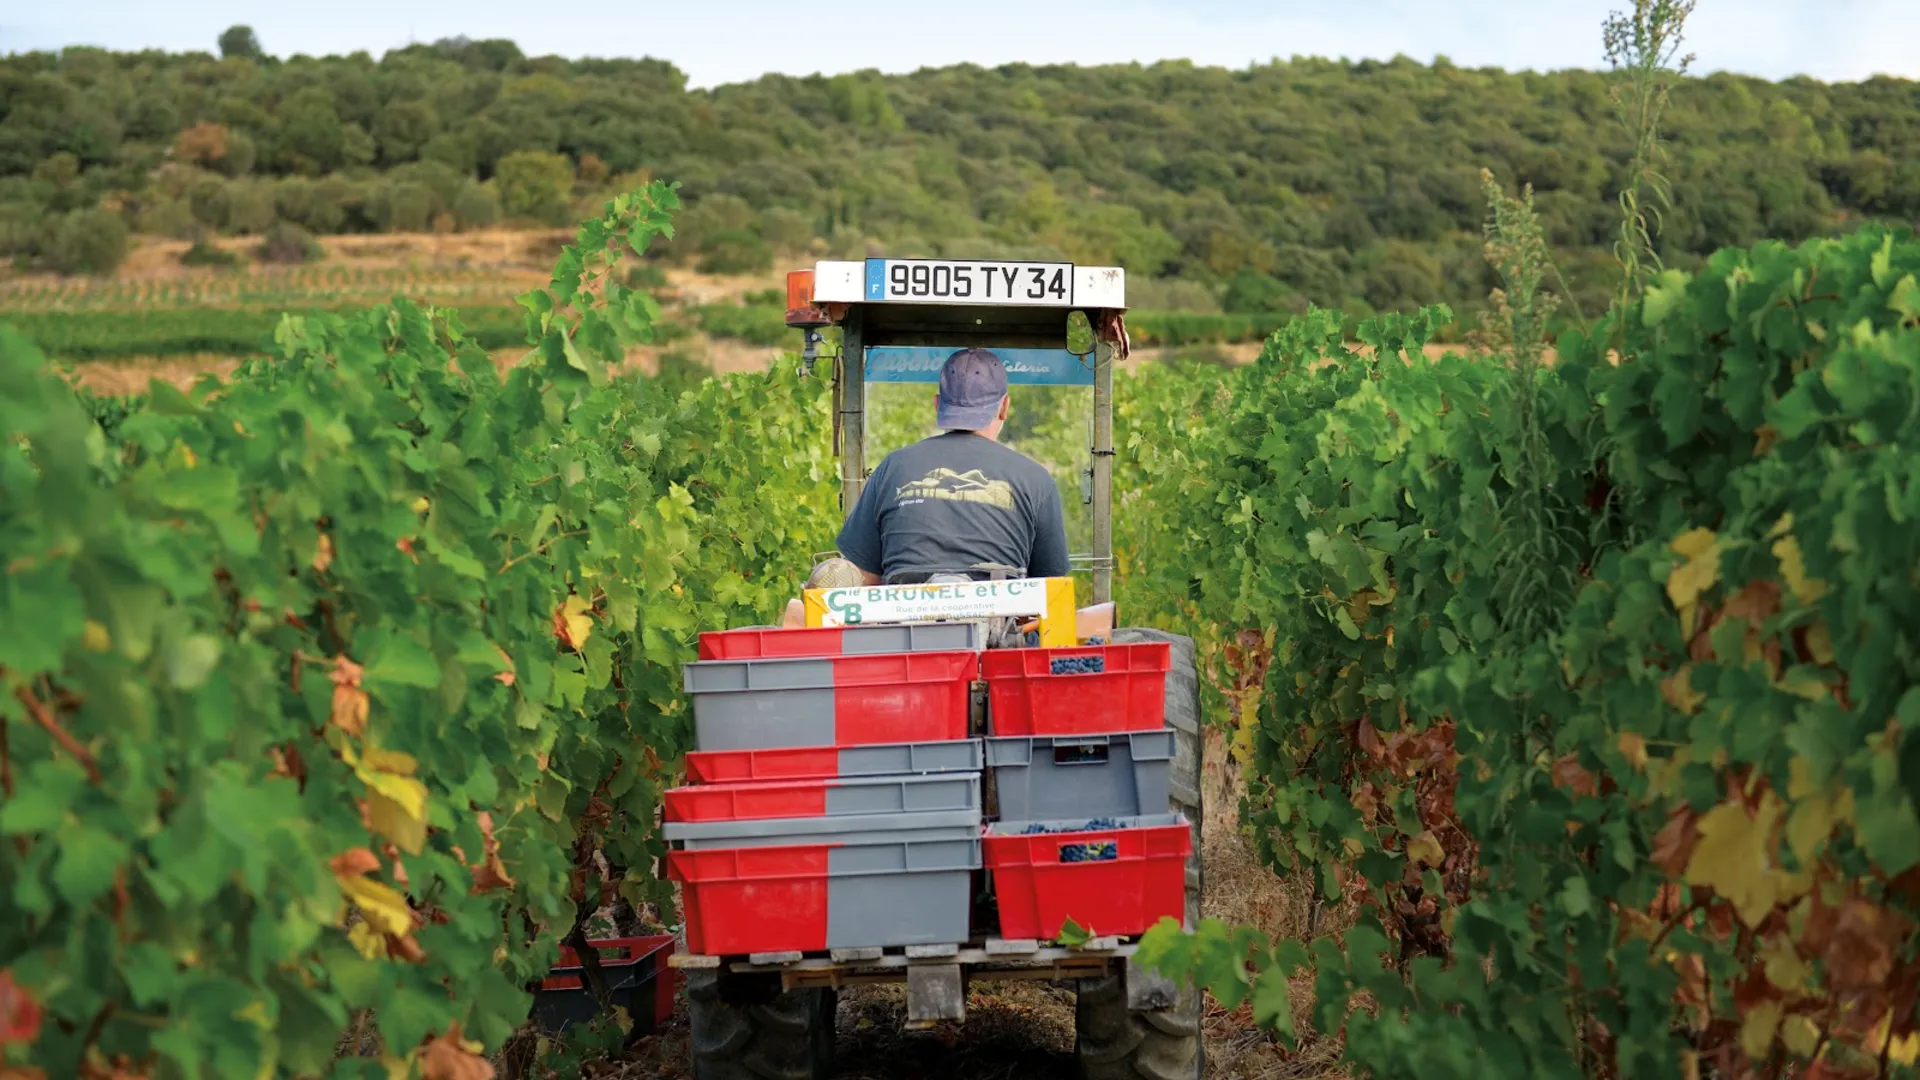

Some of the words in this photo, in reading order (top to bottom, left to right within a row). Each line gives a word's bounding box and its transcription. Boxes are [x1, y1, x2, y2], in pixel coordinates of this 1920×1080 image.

[872, 284, 880, 294] F
[891, 265, 972, 297] 9905
[980, 266, 1019, 299] TY
[1026, 268, 1066, 300] 34
[867, 582, 965, 602] BRUNEL
[975, 584, 998, 597] et
[896, 605, 913, 613] Rue
[916, 604, 928, 612] de
[930, 604, 939, 612] la
